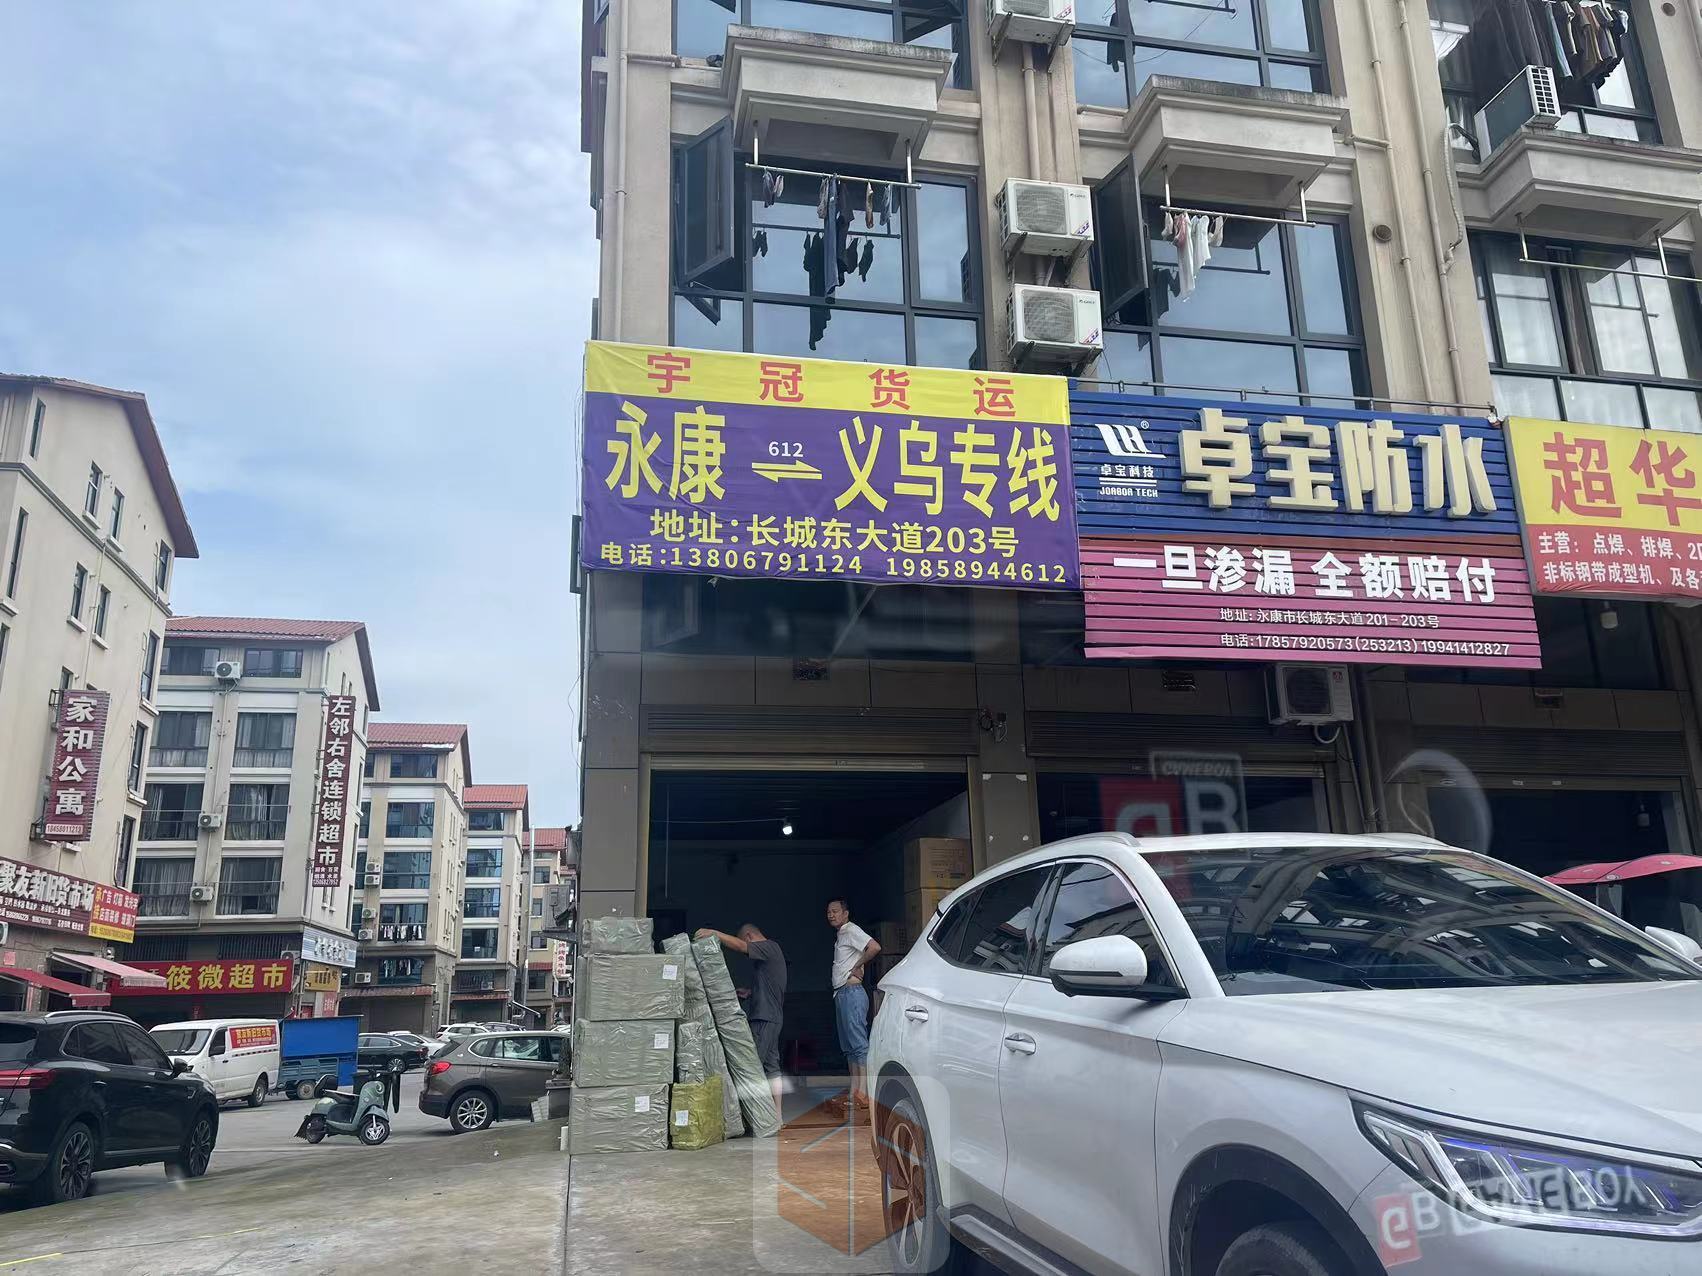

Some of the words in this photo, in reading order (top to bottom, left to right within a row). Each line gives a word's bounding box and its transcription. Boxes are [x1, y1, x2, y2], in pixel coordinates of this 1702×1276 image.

[647, 352, 1016, 417] 宇冠货运
[605, 401, 726, 504] 永康
[768, 441, 804, 457] 612
[834, 415, 1060, 521] 义乌专线
[1101, 464, 1154, 478] 卓宝科技
[1136, 488, 1158, 498] TECH
[1178, 407, 1497, 519] 卓宝防水
[1543, 431, 1702, 527] 超华
[886, 557, 1066, 583] 19858944612
[1113, 544, 1296, 596] 一旦渗漏
[1310, 552, 1496, 603] 全额赔付
[55, 696, 97, 816] 家和公寓
[318, 696, 352, 866] 左邻右舍连锁超市
